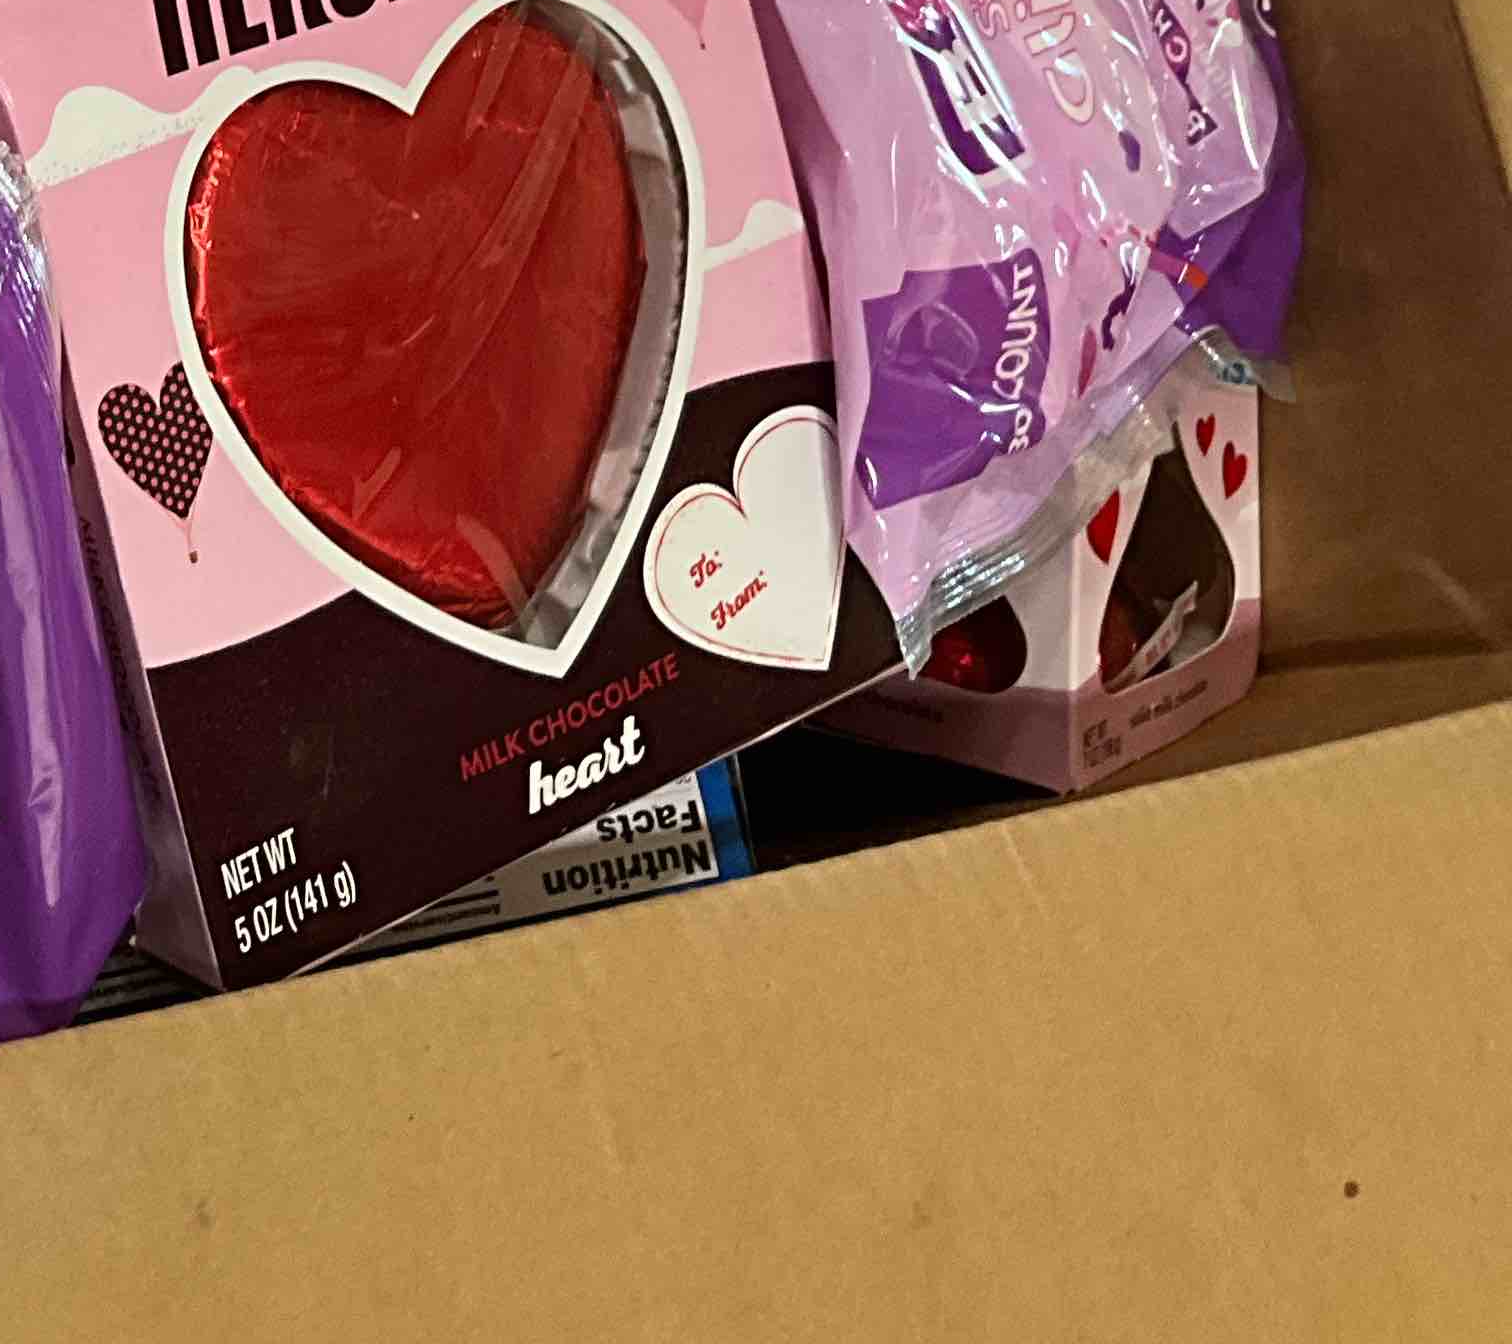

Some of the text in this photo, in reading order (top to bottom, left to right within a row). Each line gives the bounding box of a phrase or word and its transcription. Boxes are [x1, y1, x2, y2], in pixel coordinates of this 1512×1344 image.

[993, 264, 1037, 400] COUNT
[687, 547, 724, 591] To:
[710, 569, 770, 631] From:
[458, 652, 682, 783] MILK CHOCOLATE
[528, 716, 646, 815] heart
[596, 796, 704, 844] Facts
[221, 827, 298, 900] NET WT
[543, 836, 711, 900] Nutrition
[235, 861, 358, 955] 5 OZ (141 g)
